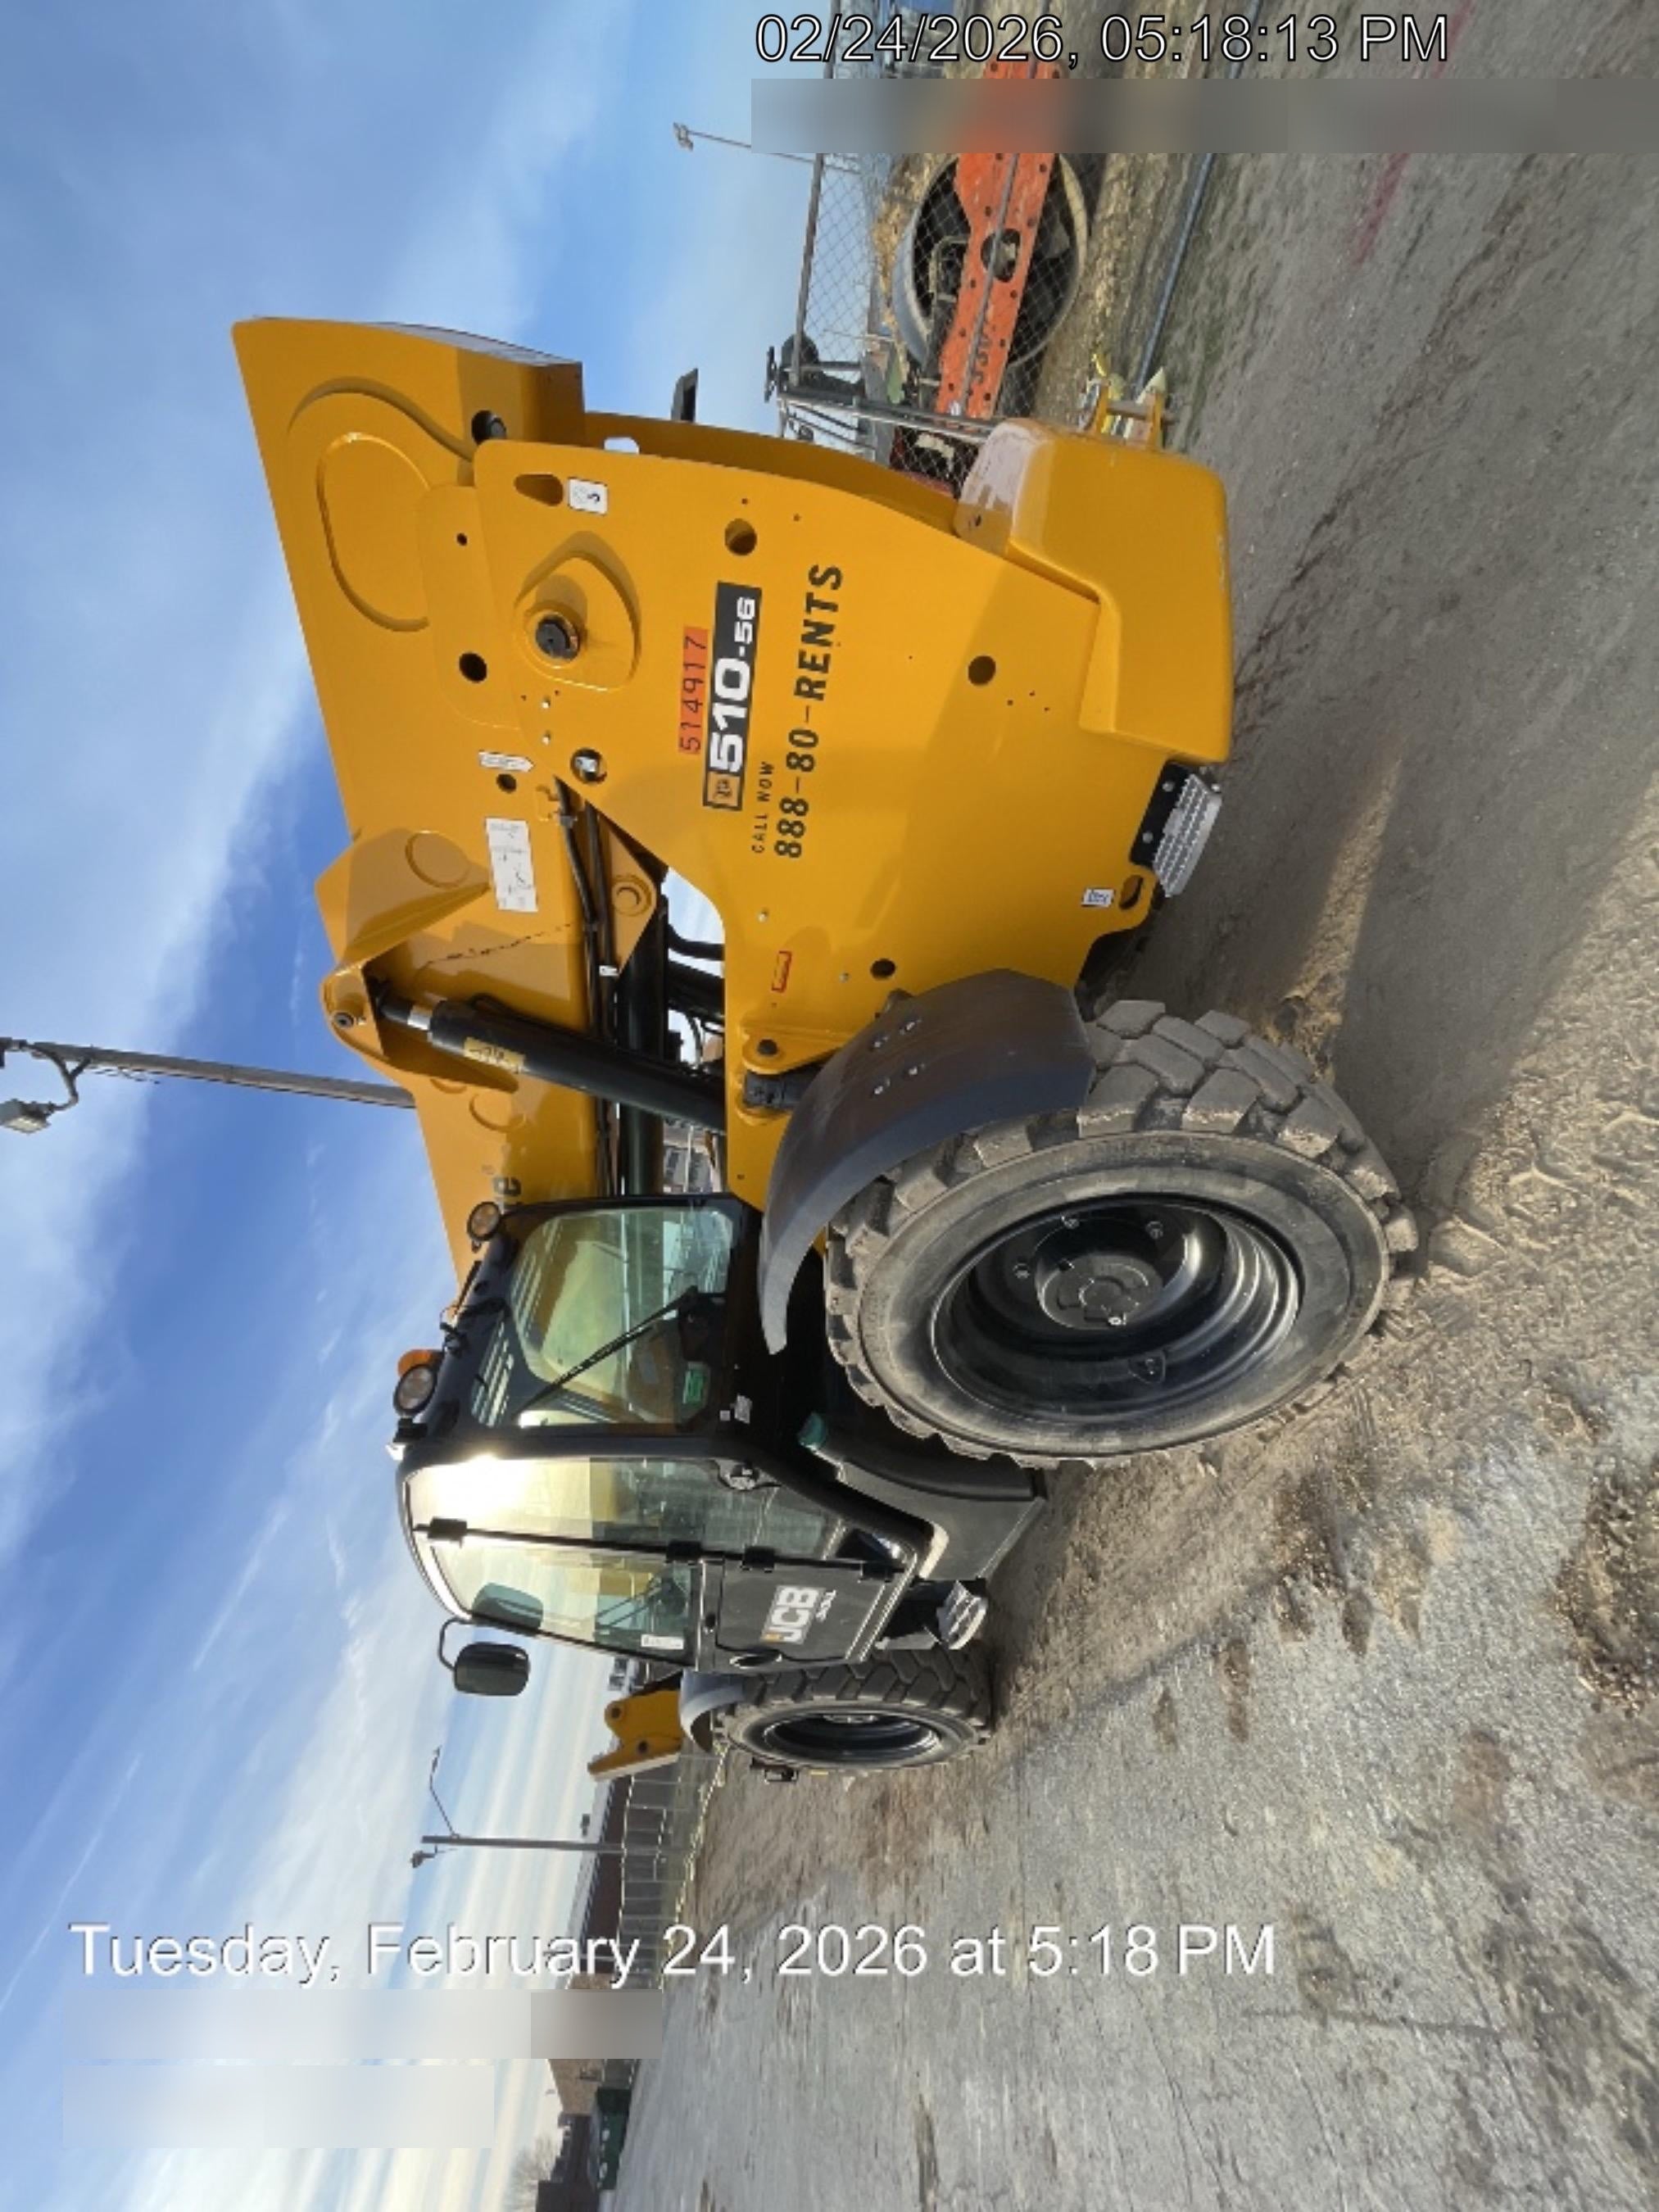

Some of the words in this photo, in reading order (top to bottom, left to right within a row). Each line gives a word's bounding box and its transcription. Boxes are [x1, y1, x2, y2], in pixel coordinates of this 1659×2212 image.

[773, 564, 843, 859] 888-80-RENTS
[757, 761, 774, 802] NOW
[752, 812, 768, 854] CALL
[762, 1586, 819, 1643] JCB
